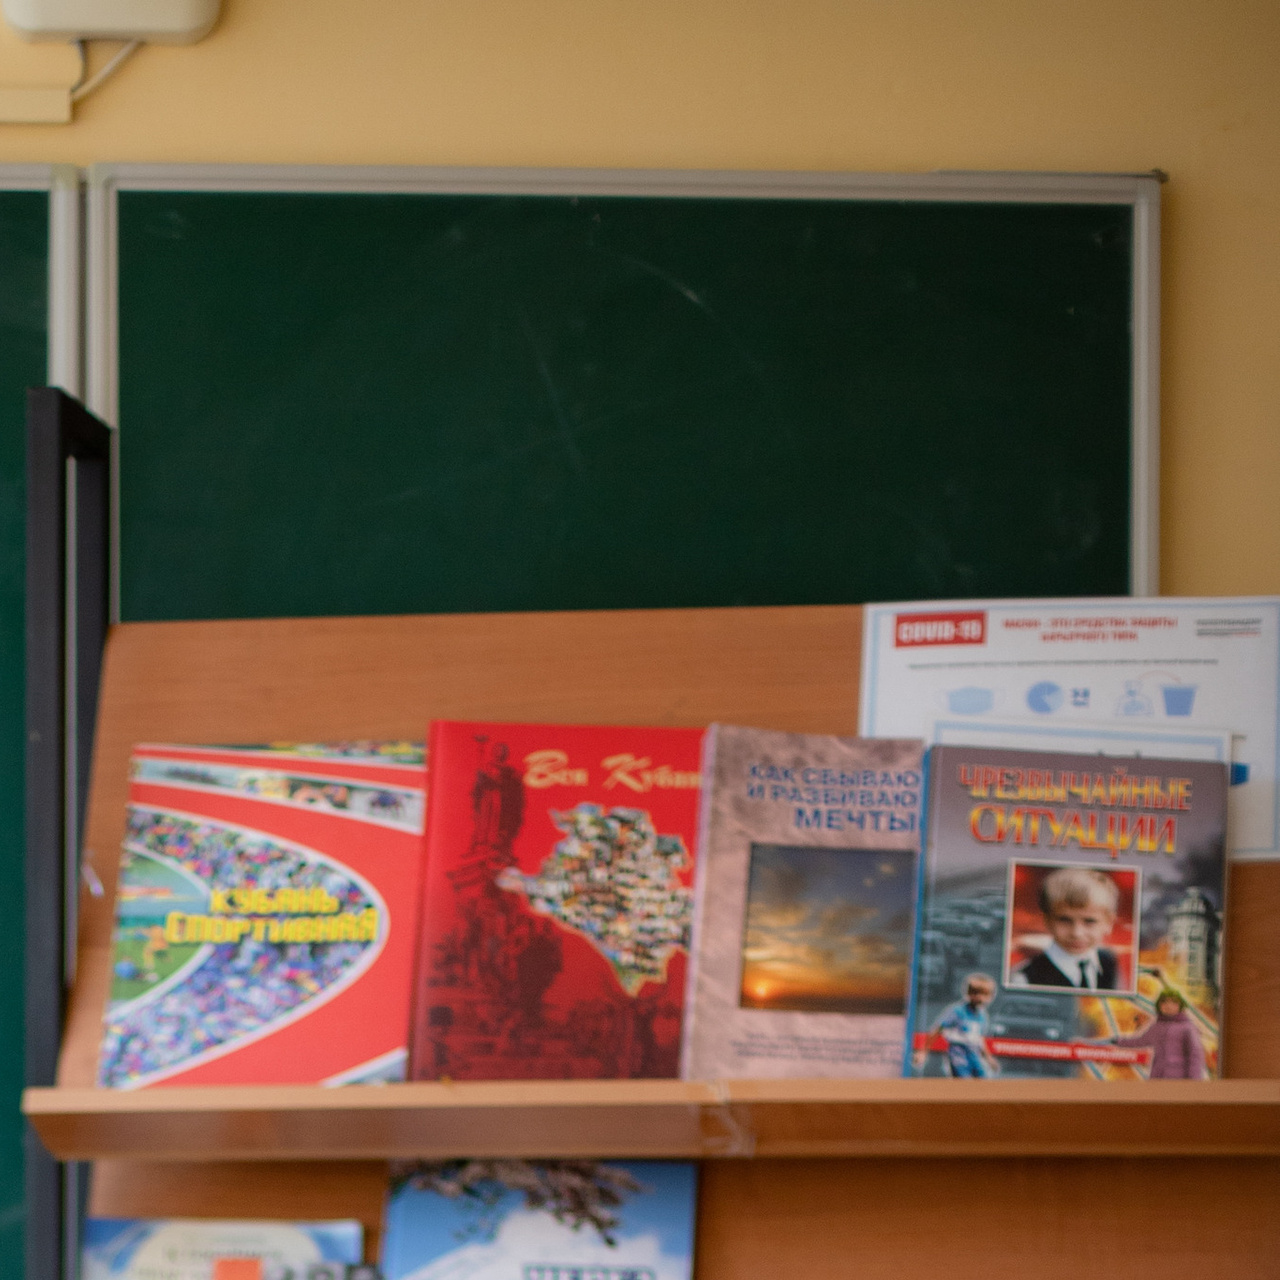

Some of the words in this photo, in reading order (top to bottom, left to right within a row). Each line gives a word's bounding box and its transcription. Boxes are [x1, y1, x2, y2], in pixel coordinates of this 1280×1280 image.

[898, 620, 982, 643] COVID-19
[749, 765, 795, 782] КАК
[802, 767, 920, 787] СБЫВАЮ
[959, 764, 1193, 811] ЧРЕЗВЫЧАЙНЫЕ
[747, 782, 765, 798] И
[771, 784, 918, 807] РАЗБИВАЮ
[795, 807, 917, 831] МЕЧТЫ
[969, 802, 1177, 860] СИТУАЦИИ
